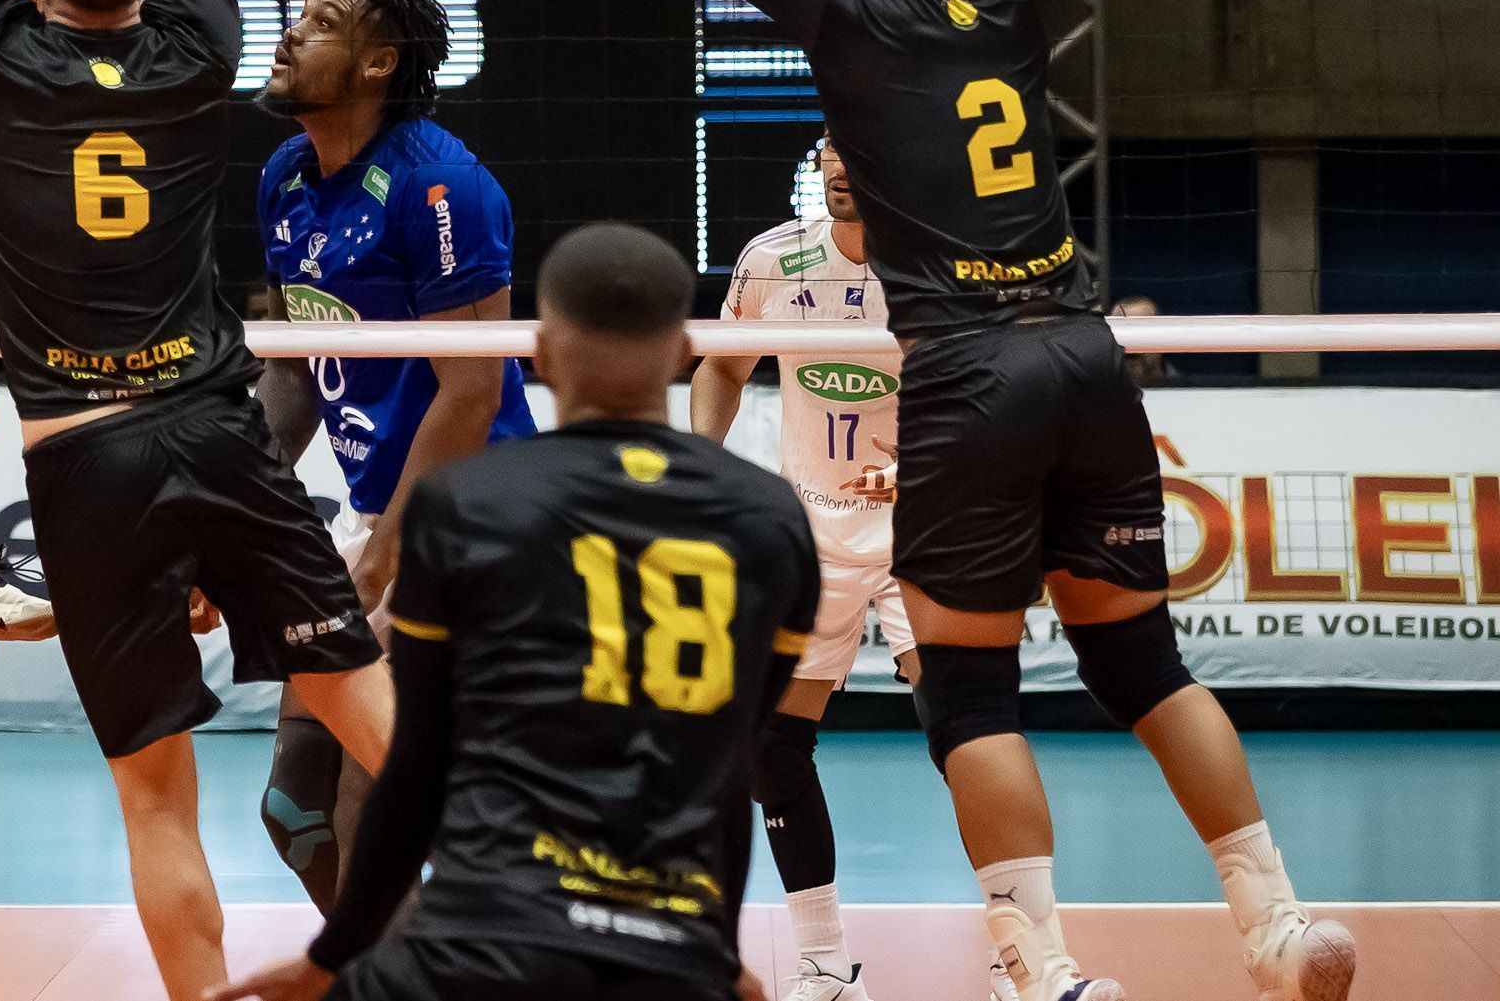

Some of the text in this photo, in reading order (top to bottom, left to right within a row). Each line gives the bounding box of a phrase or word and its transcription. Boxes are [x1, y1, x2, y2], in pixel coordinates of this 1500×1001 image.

[956, 78, 1036, 197] 2
[73, 132, 150, 240] 6
[435, 199, 456, 276] emcash
[783, 249, 823, 268] Unimed
[286, 293, 343, 321] SADA
[126, 336, 196, 371] CLUBE
[804, 370, 887, 394] SADA
[826, 411, 860, 461] 17
[571, 533, 736, 715] 18
[1256, 615, 1304, 637] DE
[765, 816, 784, 829] N1
